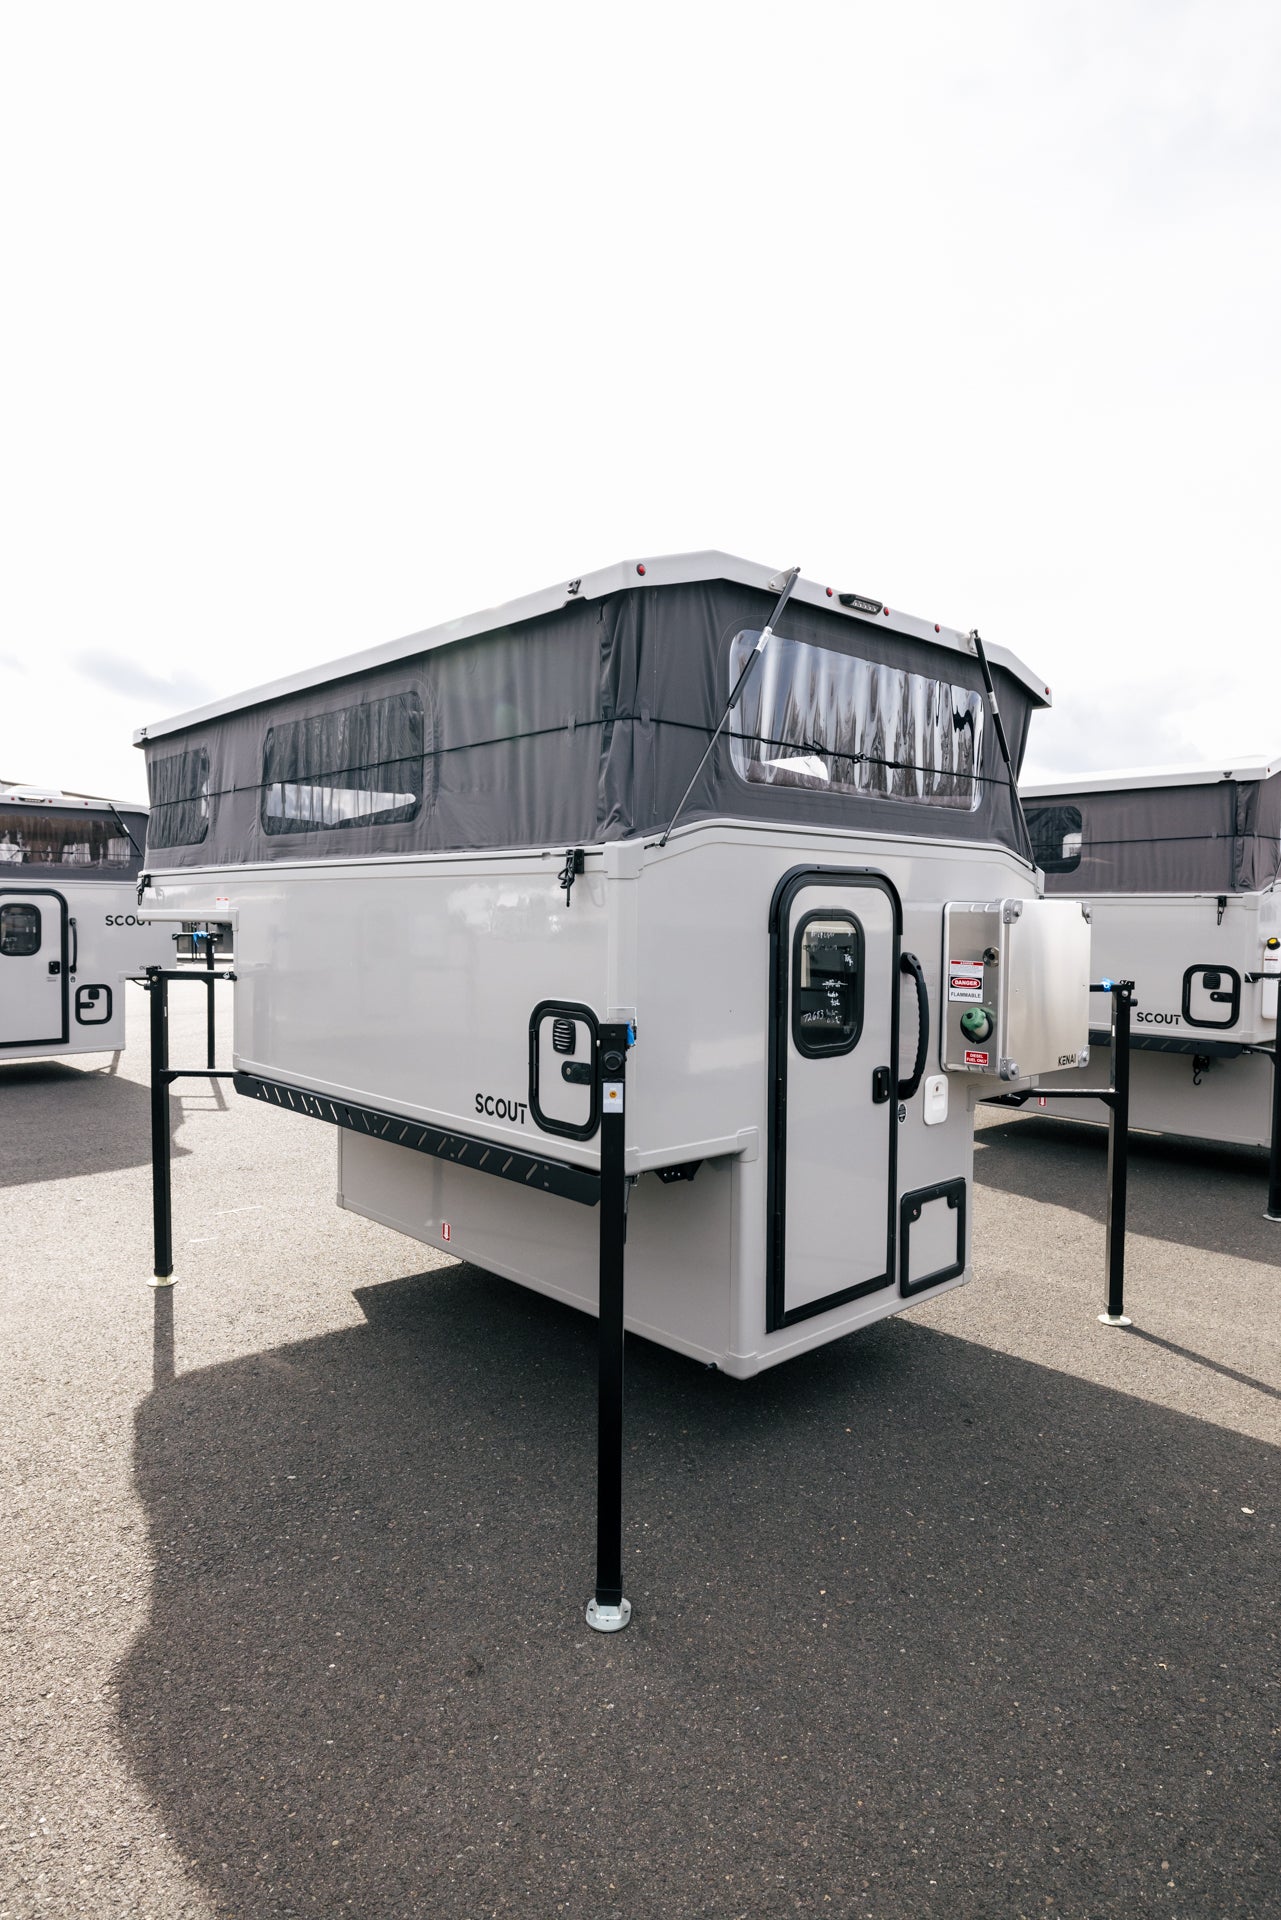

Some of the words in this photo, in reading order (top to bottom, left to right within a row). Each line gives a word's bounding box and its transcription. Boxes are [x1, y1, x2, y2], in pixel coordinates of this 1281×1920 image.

[1136, 1012, 1181, 1025] SCOUT
[1058, 1054, 1076, 1067] KENAI
[475, 1093, 527, 1124] SCOUT
